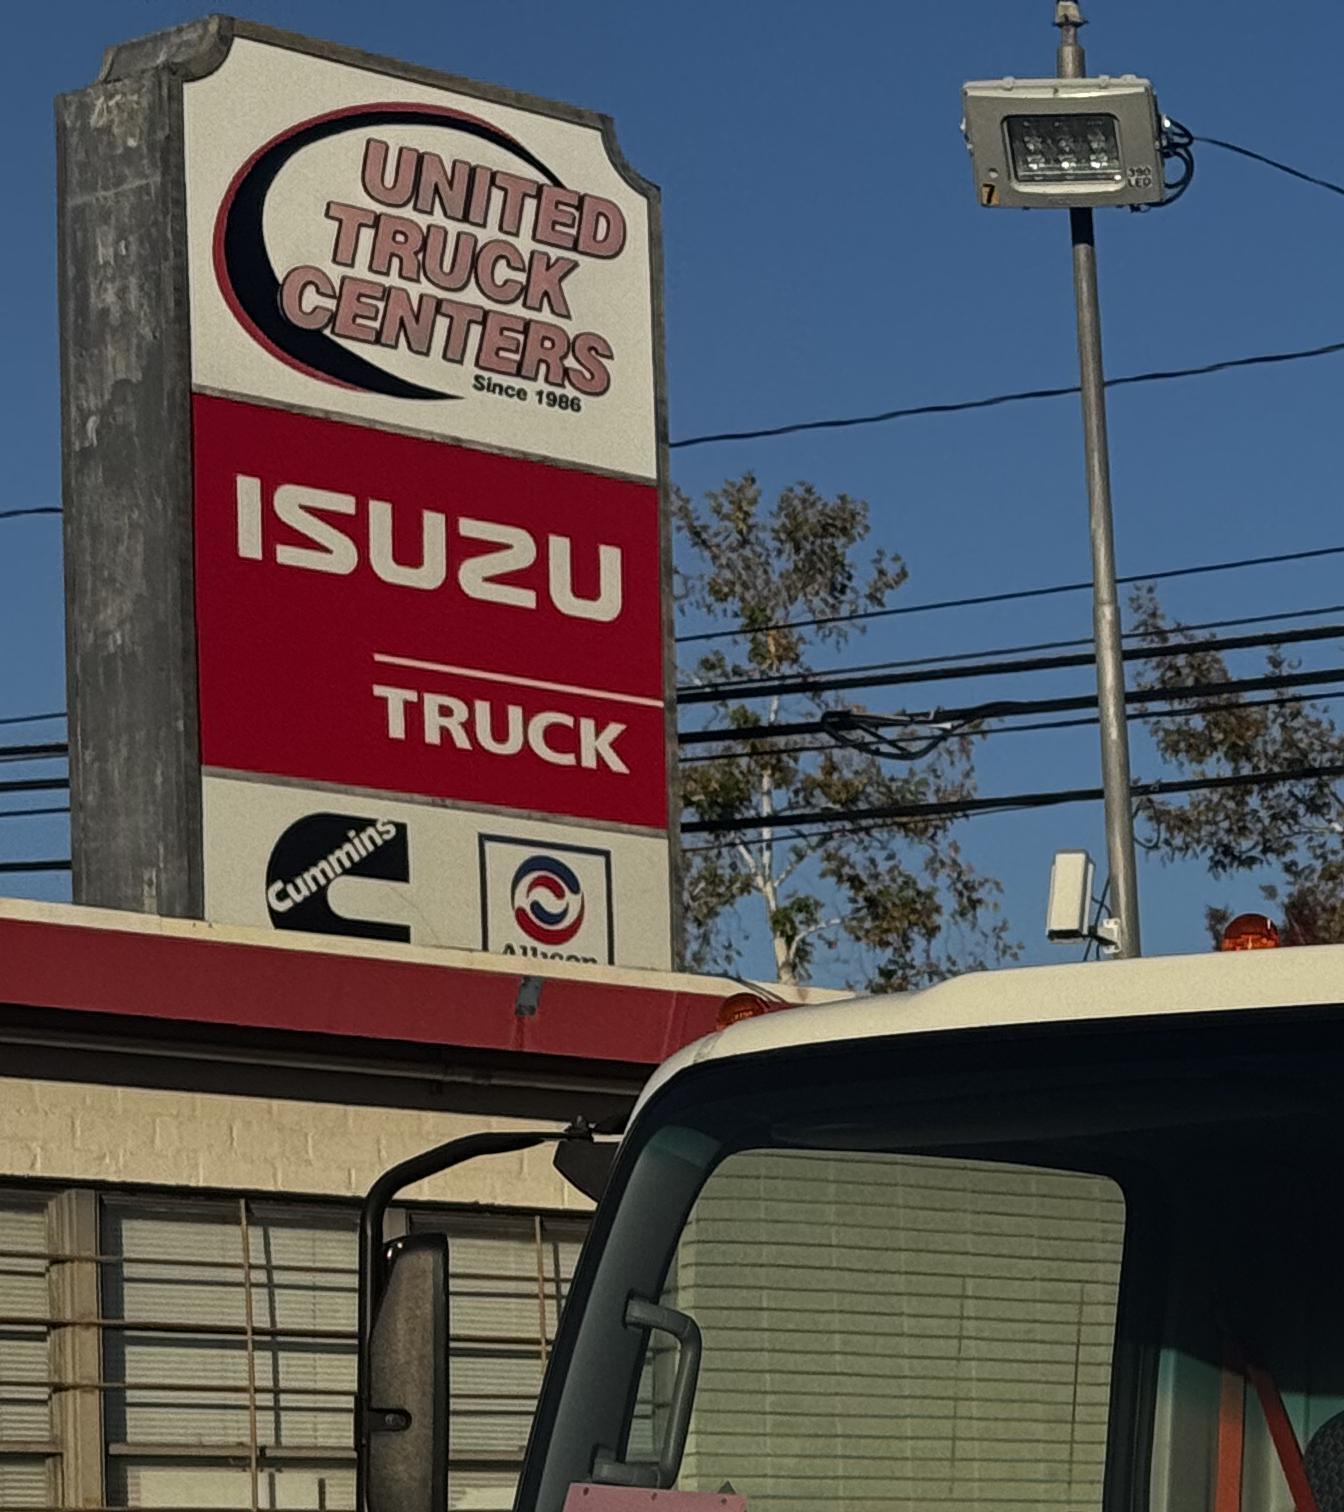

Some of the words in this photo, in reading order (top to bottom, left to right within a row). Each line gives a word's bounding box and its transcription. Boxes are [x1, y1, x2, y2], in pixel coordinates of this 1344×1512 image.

[361, 138, 627, 261] UNITED
[982, 183, 996, 204] 7
[325, 202, 579, 319] TRUCK
[279, 265, 615, 398] CENTERS
[472, 373, 528, 402] Since
[535, 388, 582, 413] 1986
[236, 474, 624, 624] ISUZU
[372, 684, 630, 775] TRUCK
[267, 818, 397, 914] Cummins
